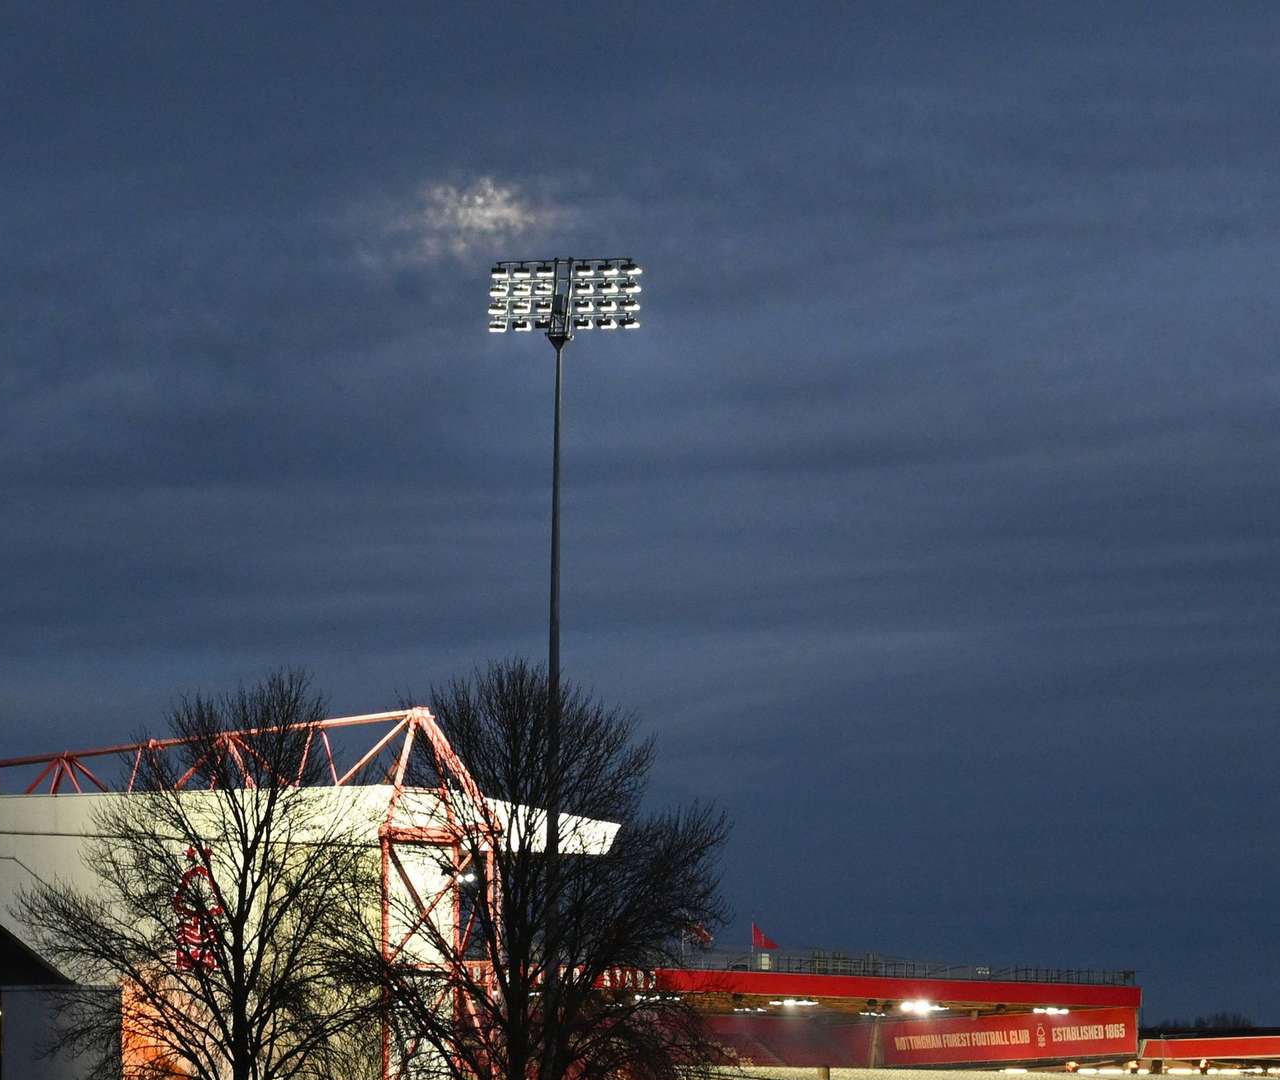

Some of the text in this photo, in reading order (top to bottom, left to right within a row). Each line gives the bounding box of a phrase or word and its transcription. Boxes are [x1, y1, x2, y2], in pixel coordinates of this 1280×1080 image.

[894, 1034, 942, 1051] NOTTINGHAM
[943, 1033, 971, 1048] FOREST
[971, 1030, 1009, 1047] FOOTBALL
[1009, 1029, 1031, 1044] CLUB
[1051, 1024, 1104, 1042] ESTABLISHED
[1104, 1023, 1126, 1039] 1865
